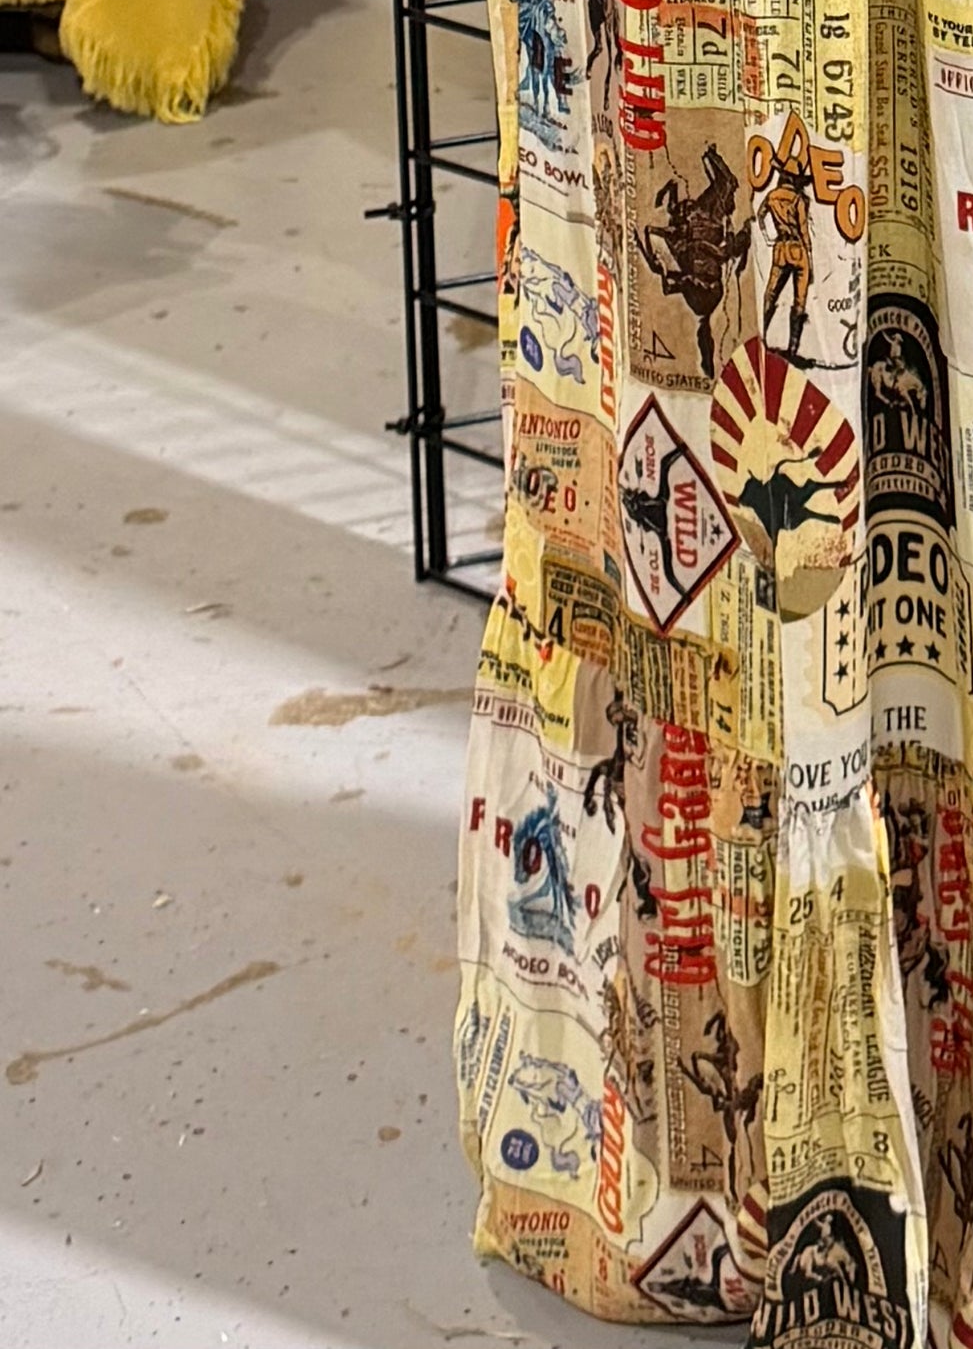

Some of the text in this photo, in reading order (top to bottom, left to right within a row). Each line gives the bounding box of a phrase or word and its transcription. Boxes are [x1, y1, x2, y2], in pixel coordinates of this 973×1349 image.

[933, 29, 949, 42] BY
[822, 59, 855, 143] 6743
[544, 161, 589, 190] BOWL
[900, 144, 919, 213] 1919
[673, 479, 698, 569] WILD
[896, 594, 947, 638] ONE
[884, 706, 927, 732] THE
[789, 891, 813, 926] 25
[866, 1033, 890, 1103] LEAGUE
